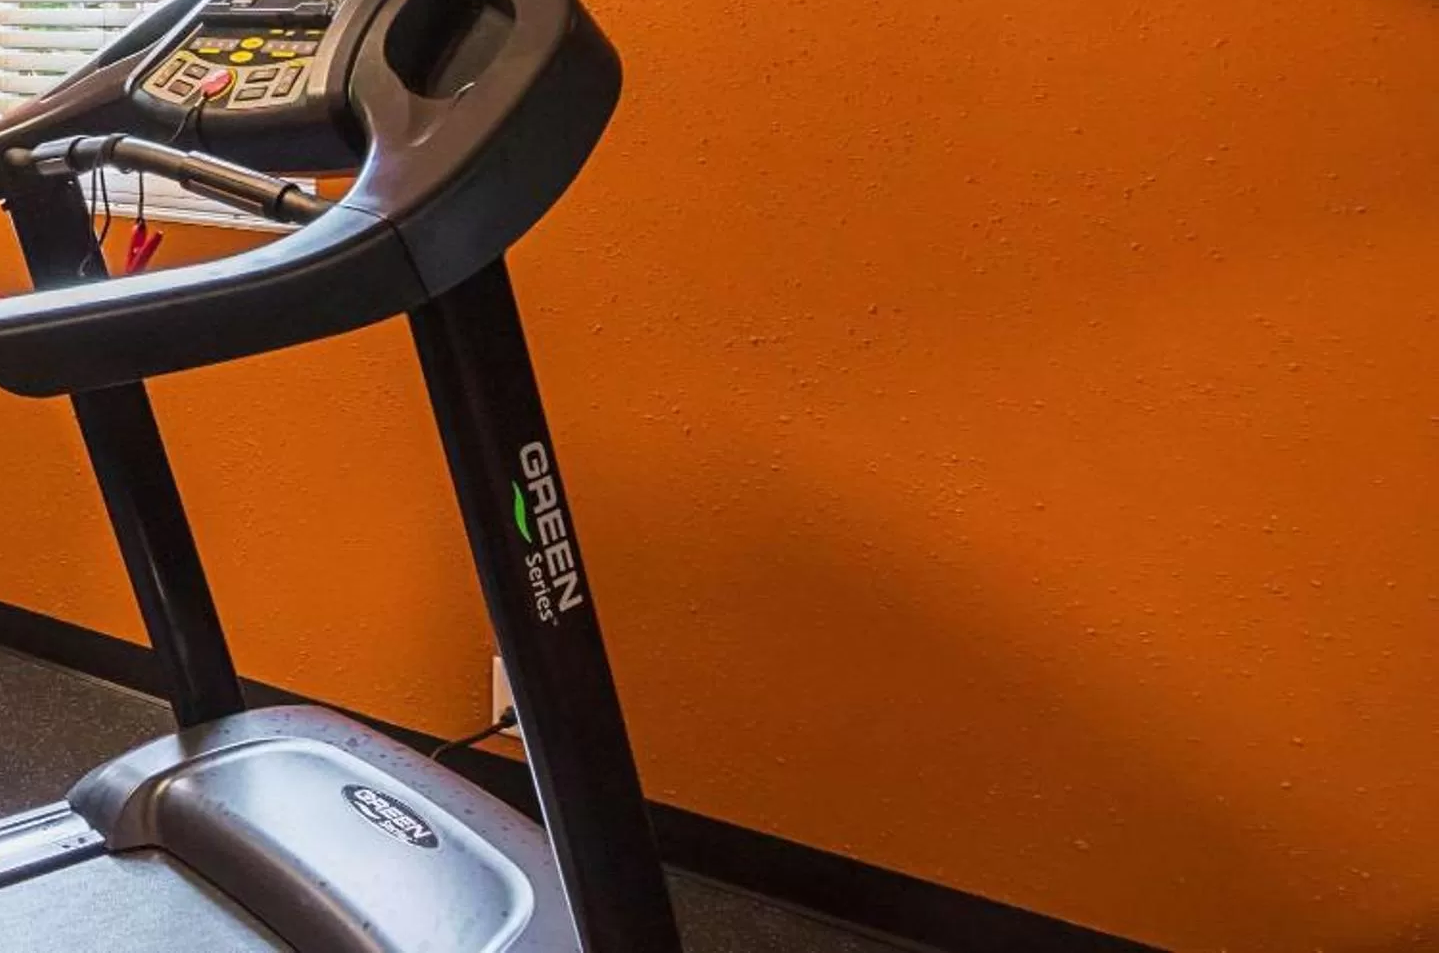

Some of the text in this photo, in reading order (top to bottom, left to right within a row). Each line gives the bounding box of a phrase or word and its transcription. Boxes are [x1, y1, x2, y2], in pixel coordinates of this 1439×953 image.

[519, 441, 584, 613] GREEN
[524, 552, 554, 622] Series
[354, 789, 432, 838] GREEN
